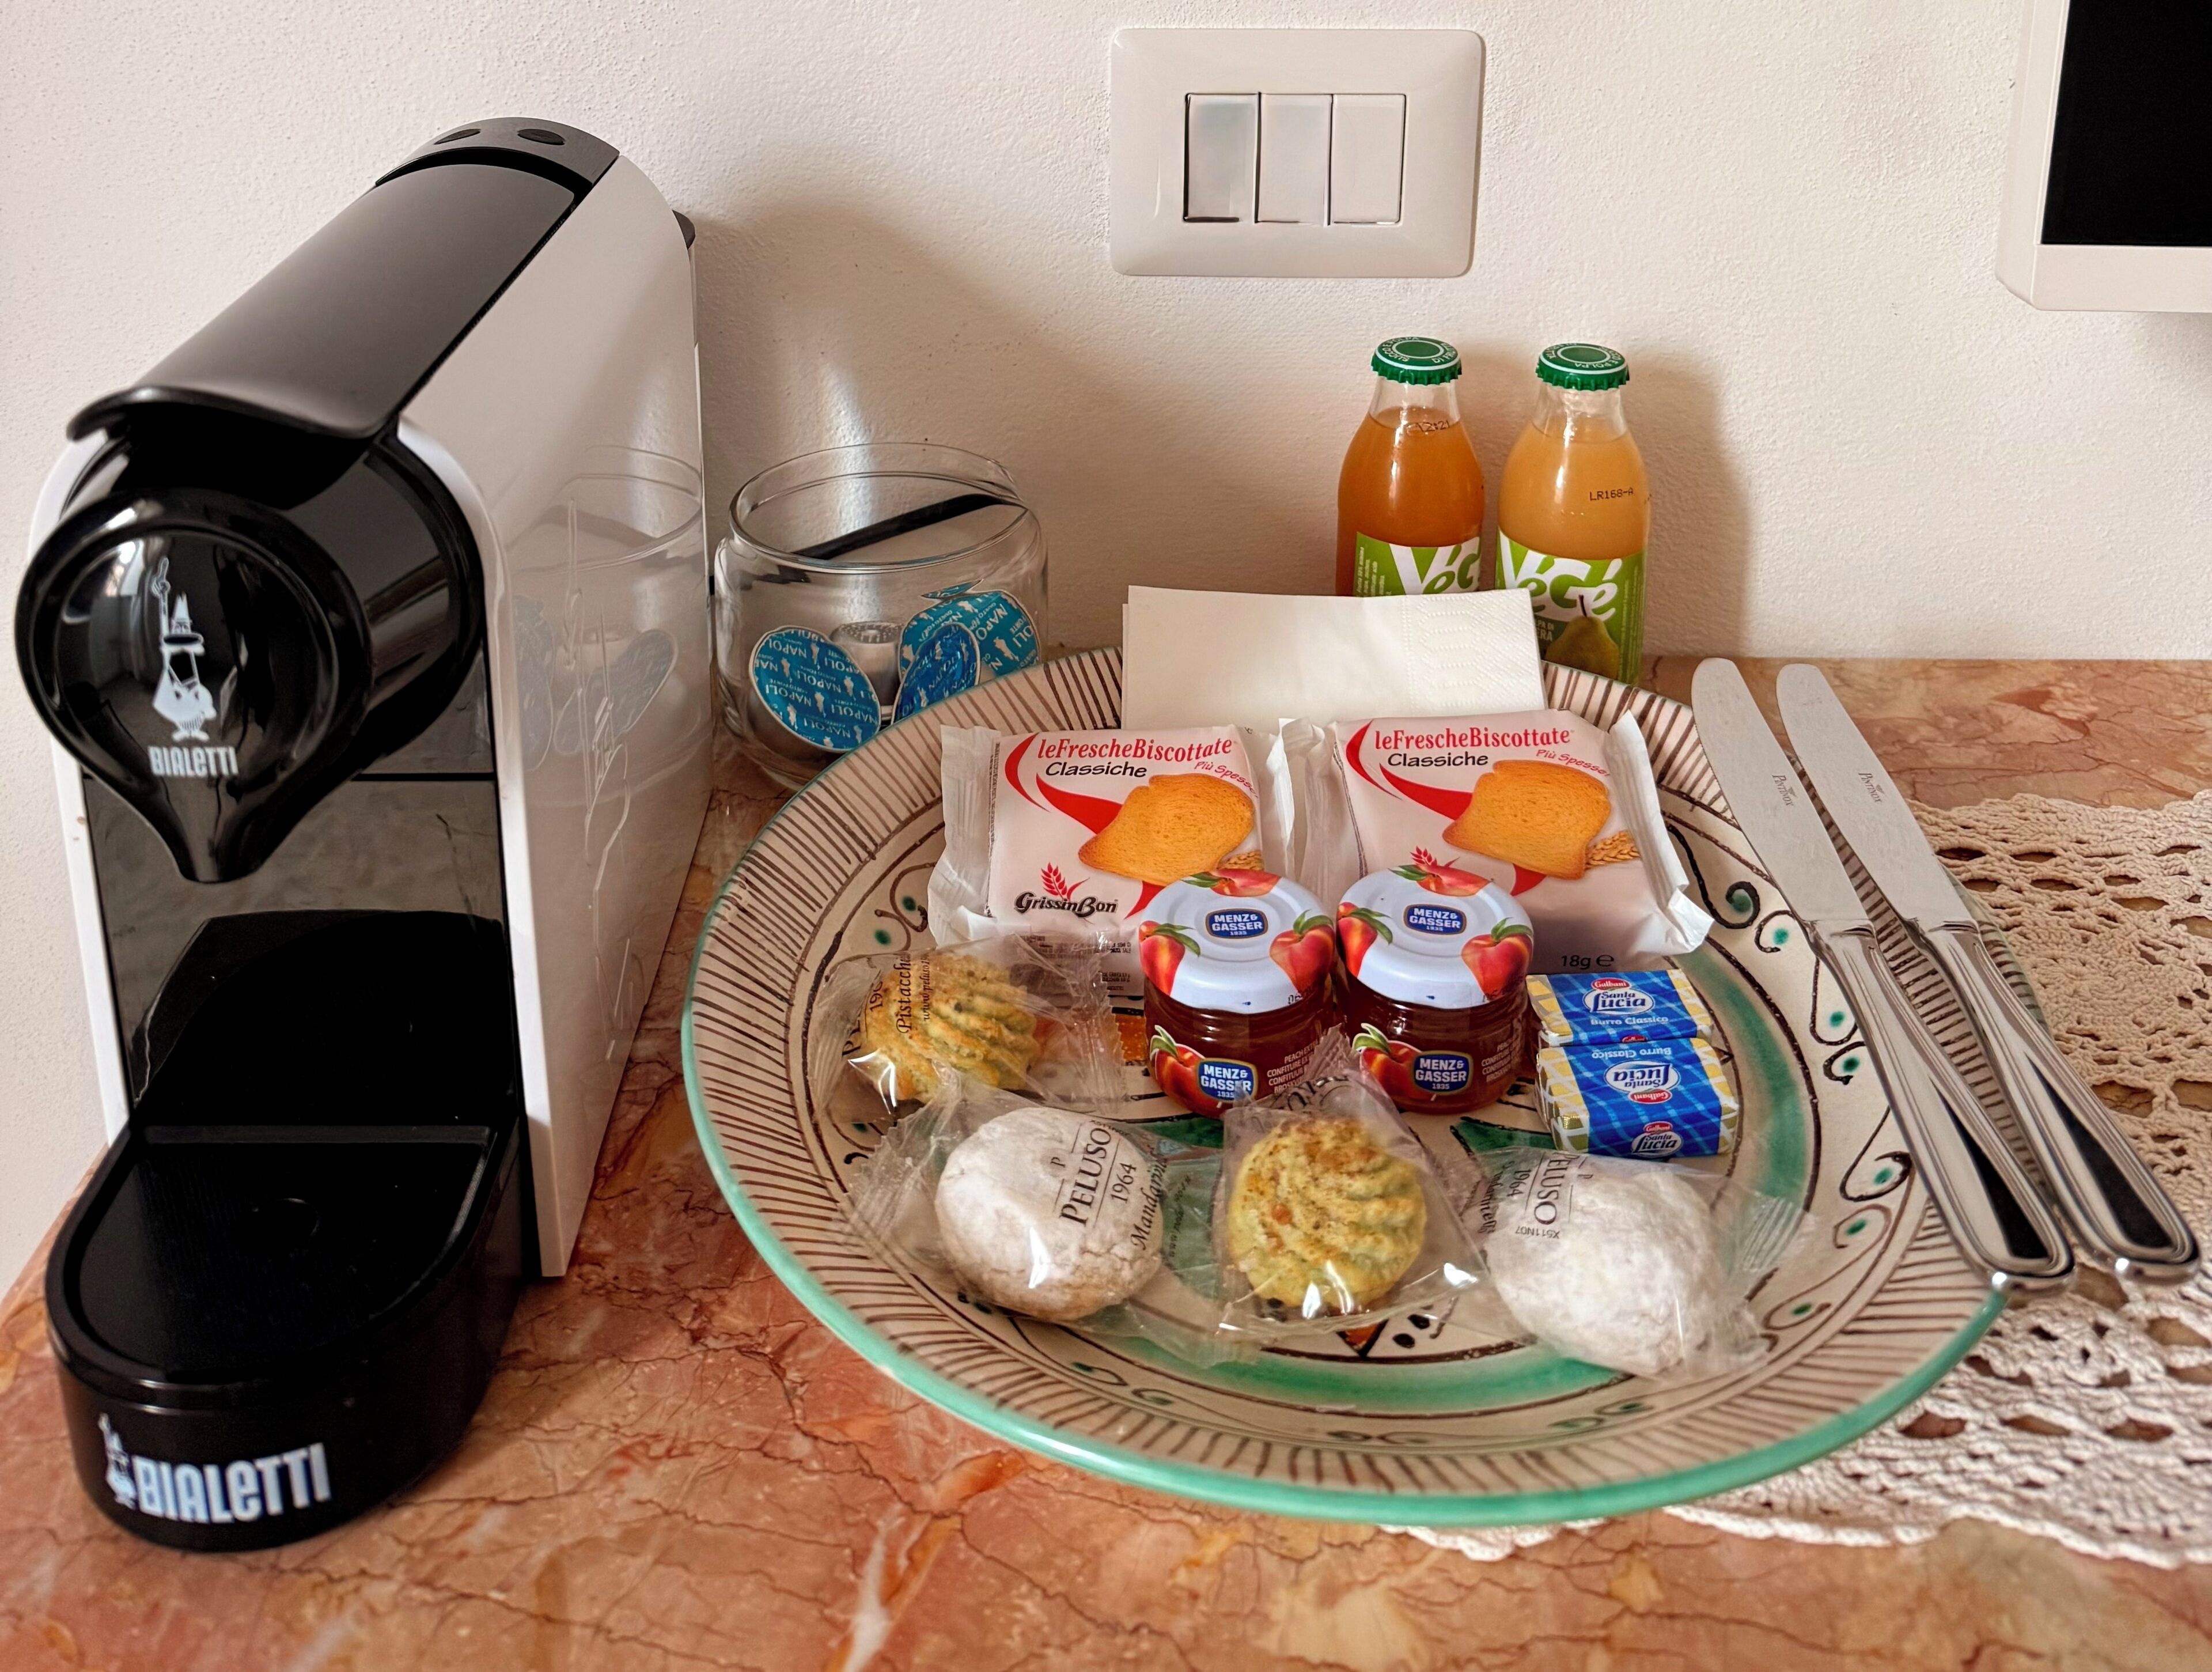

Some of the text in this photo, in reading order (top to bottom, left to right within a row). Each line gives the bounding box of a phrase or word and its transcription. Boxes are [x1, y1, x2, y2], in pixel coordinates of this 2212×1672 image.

[1590, 487, 1633, 501] LR168-A
[797, 669, 842, 693] NAPOLI
[766, 684, 812, 707] NAPOLI
[804, 718, 851, 739] NAPOLI
[1388, 751, 1488, 767] Classiche
[1536, 749, 1556, 759] Più
[1046, 761, 1147, 777] Classiche
[1194, 761, 1214, 770] Più
[1014, 891, 1118, 918] GrissinBon
[1211, 921, 1263, 931] GASSER
[1409, 915, 1461, 929] GASSER
[1560, 954, 1591, 969] 18g
[1594, 980, 1627, 988] Galbani
[1592, 992, 1646, 1012] Lucia
[1601, 991, 1636, 999] Santa
[1624, 1016, 1669, 1025] Classico
[1285, 1049, 1304, 1064] PEACH
[1591, 1047, 1672, 1060] Burro Classico
[1267, 1060, 1301, 1077] CONFITURE
[1415, 1069, 1467, 1083] GASSER
[1613, 1064, 1671, 1087] Lucia
[1624, 1079, 1661, 1089] Santa
[1634, 1091, 1669, 1100] Galbani
[1632, 1134, 1677, 1153] Lucia
[1646, 1133, 1672, 1141] Santa
[1050, 1156, 1066, 1168] P
[1059, 1127, 1112, 1228] PELUSO
[1111, 1162, 1137, 1204] 1964
[1507, 1168, 1532, 1198] 1964
[1533, 1152, 1581, 1225] PELUSO
[1515, 1225, 1560, 1239] X511N07
